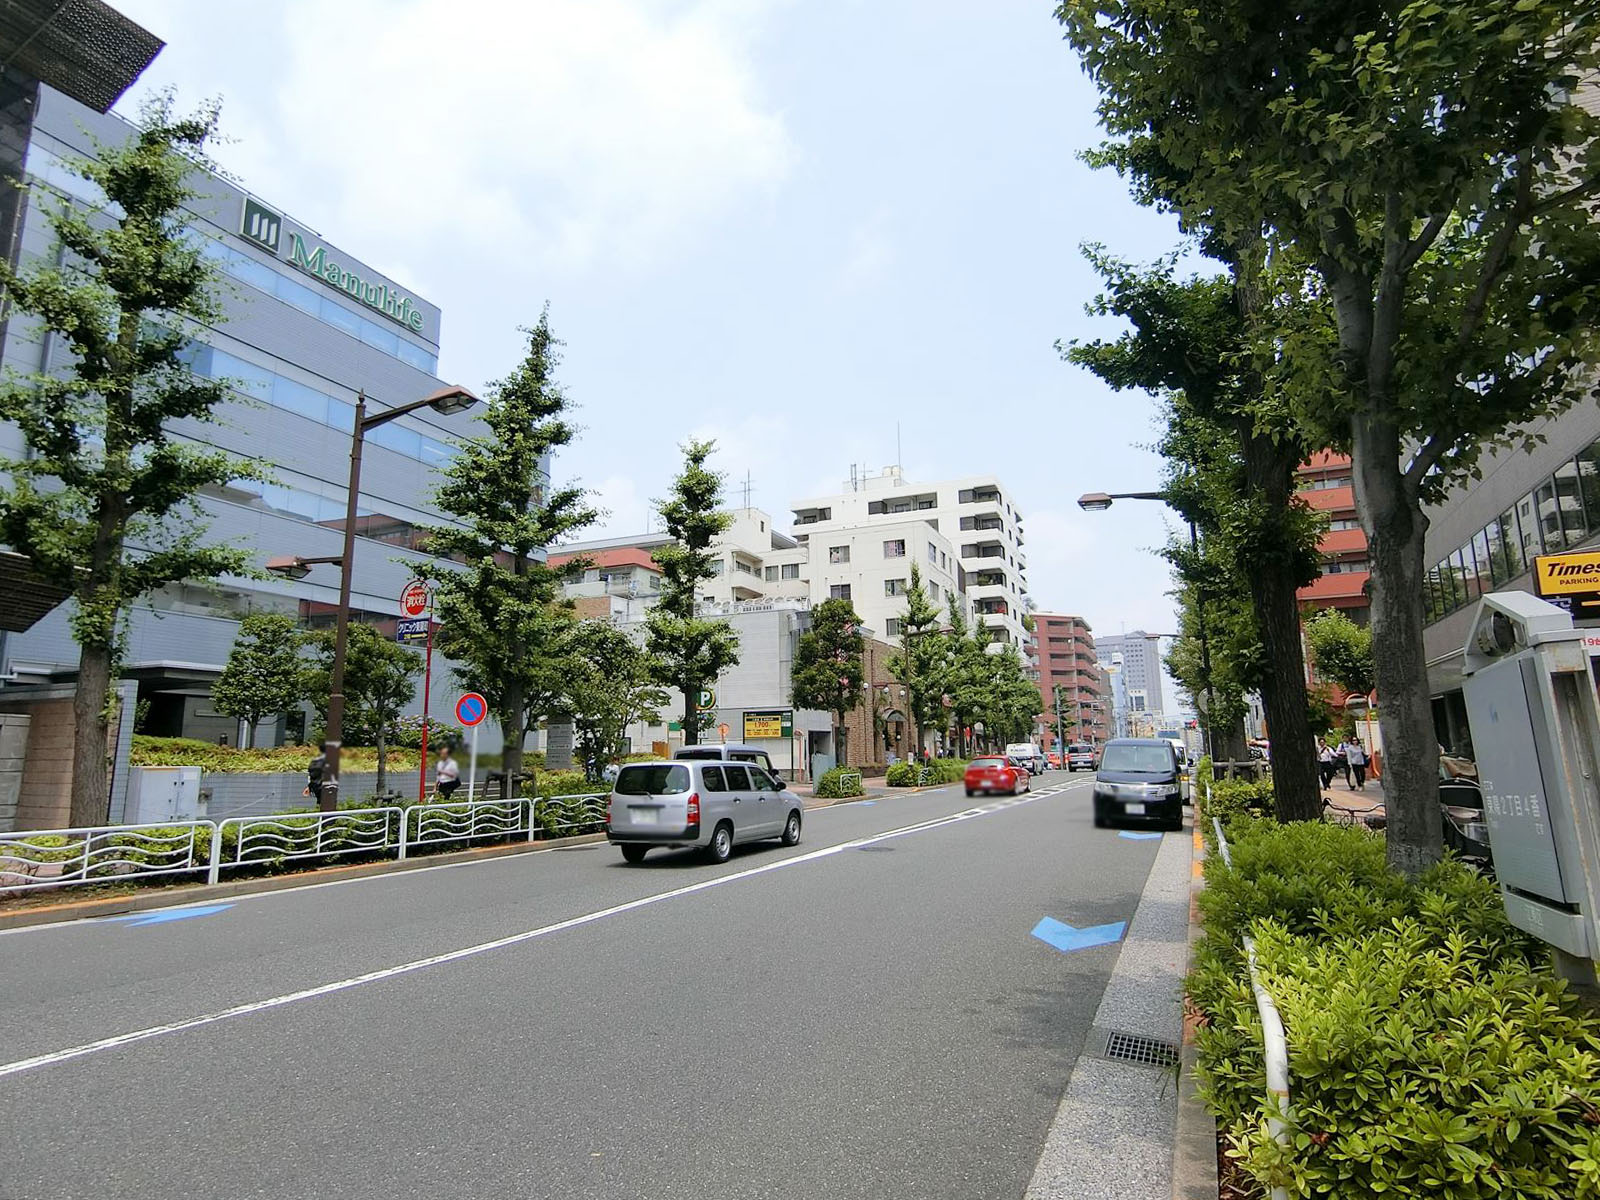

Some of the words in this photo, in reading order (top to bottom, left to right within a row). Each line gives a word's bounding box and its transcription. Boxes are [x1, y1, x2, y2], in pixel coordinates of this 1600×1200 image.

[288, 232, 424, 331] Manulife
[1559, 577, 1599, 585] PARKING
[407, 594, 425, 607] 消火栓
[701, 691, 711, 706] P
